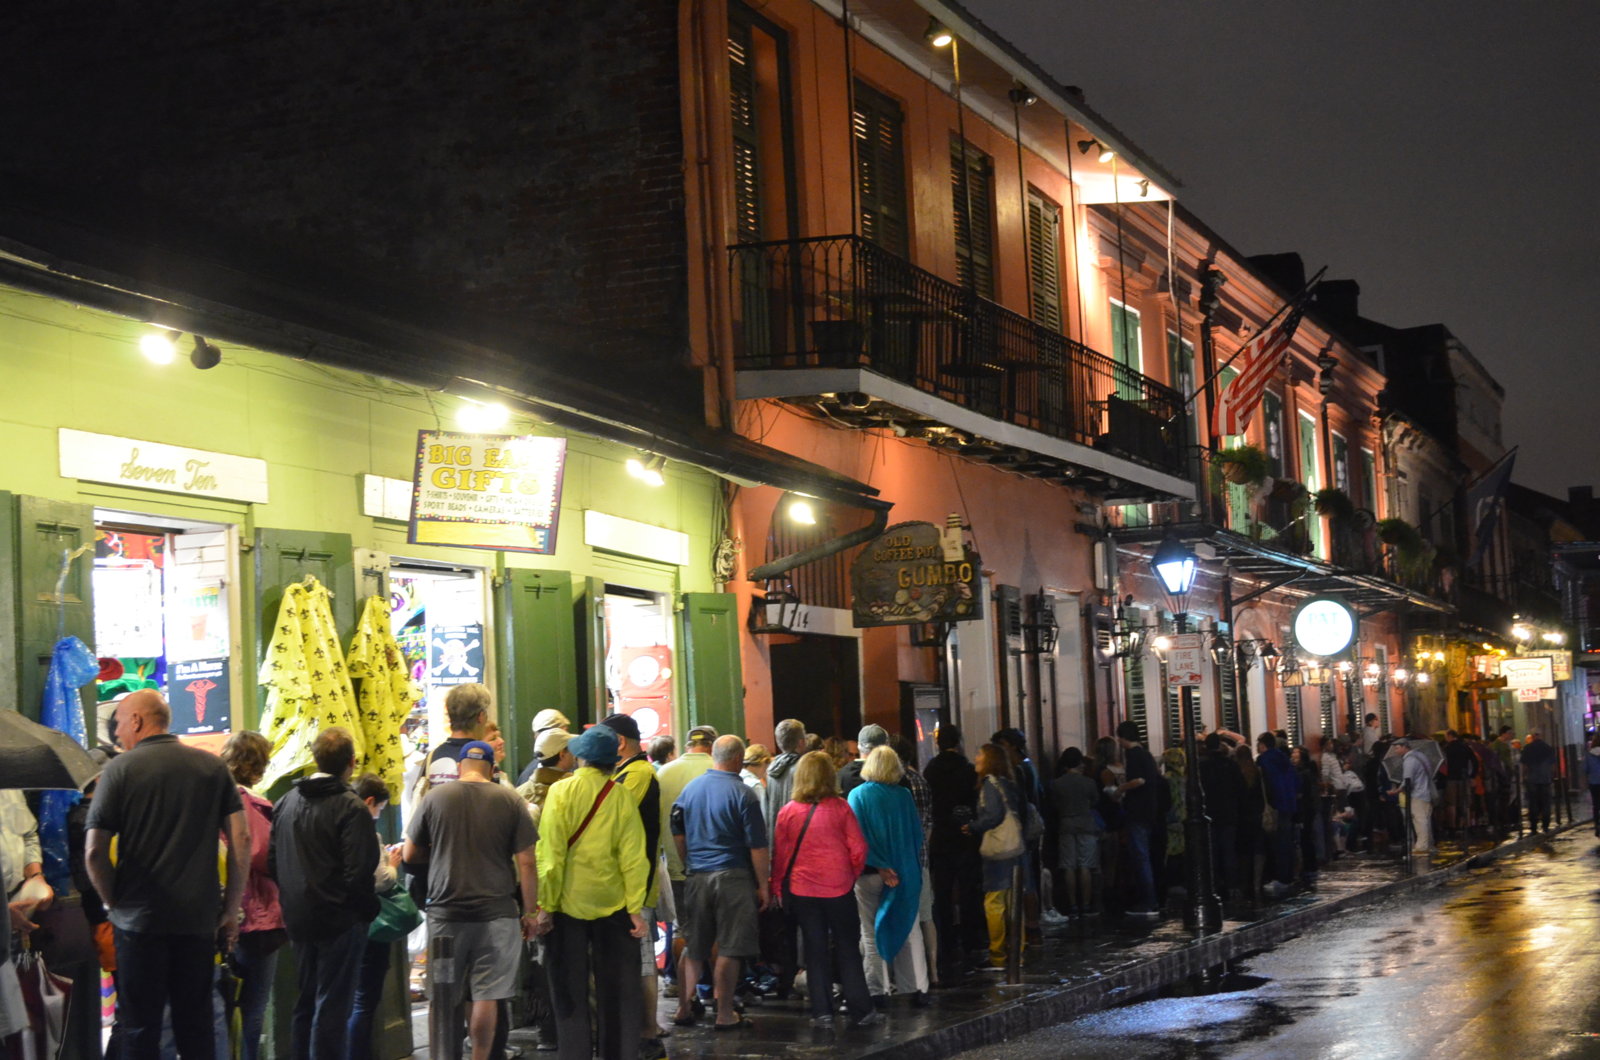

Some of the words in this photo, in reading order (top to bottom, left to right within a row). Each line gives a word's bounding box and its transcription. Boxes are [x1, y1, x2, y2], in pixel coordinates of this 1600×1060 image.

[428, 444, 472, 466] BIG
[120, 447, 176, 484] Seven
[183, 458, 218, 490] Ten
[431, 467, 541, 496] GIFTS
[424, 500, 445, 511] SPORT
[886, 535, 912, 548] OLD
[873, 547, 914, 563] COFFEE
[916, 545, 938, 559] POT
[897, 562, 974, 589] GUMBO
[1175, 651, 1193, 660] FIRE
[1520, 689, 1538, 697] ATM
